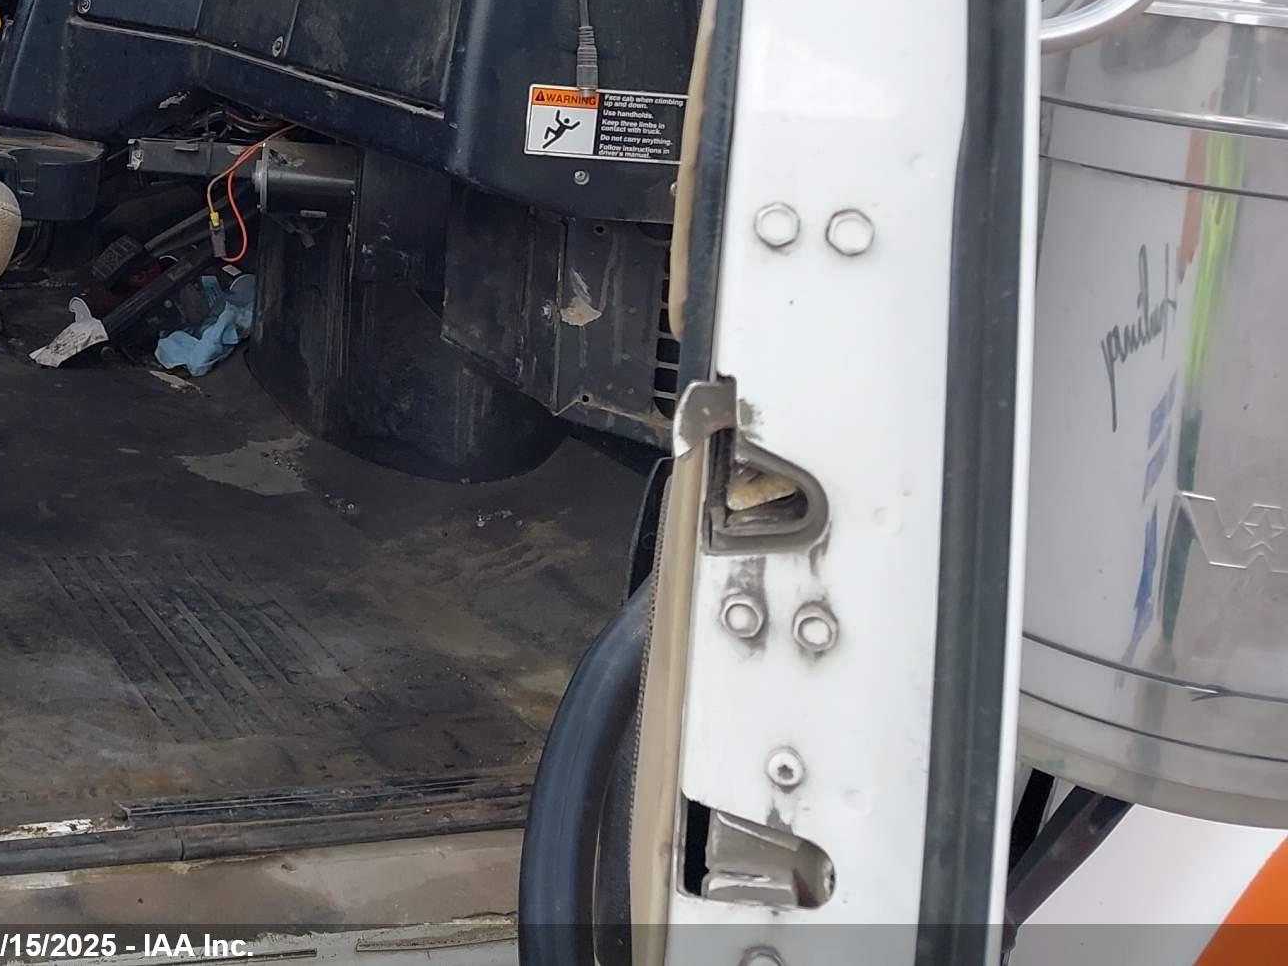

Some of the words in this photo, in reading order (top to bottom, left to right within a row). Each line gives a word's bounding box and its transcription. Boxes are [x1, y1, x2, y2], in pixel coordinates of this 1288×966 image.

[546, 93, 596, 105] WARNING
[654, 98, 684, 108] climbing
[617, 110, 654, 118] handholds.
[602, 119, 619, 128] Keep
[642, 138, 672, 146] anything.
[623, 145, 662, 154] instructions
